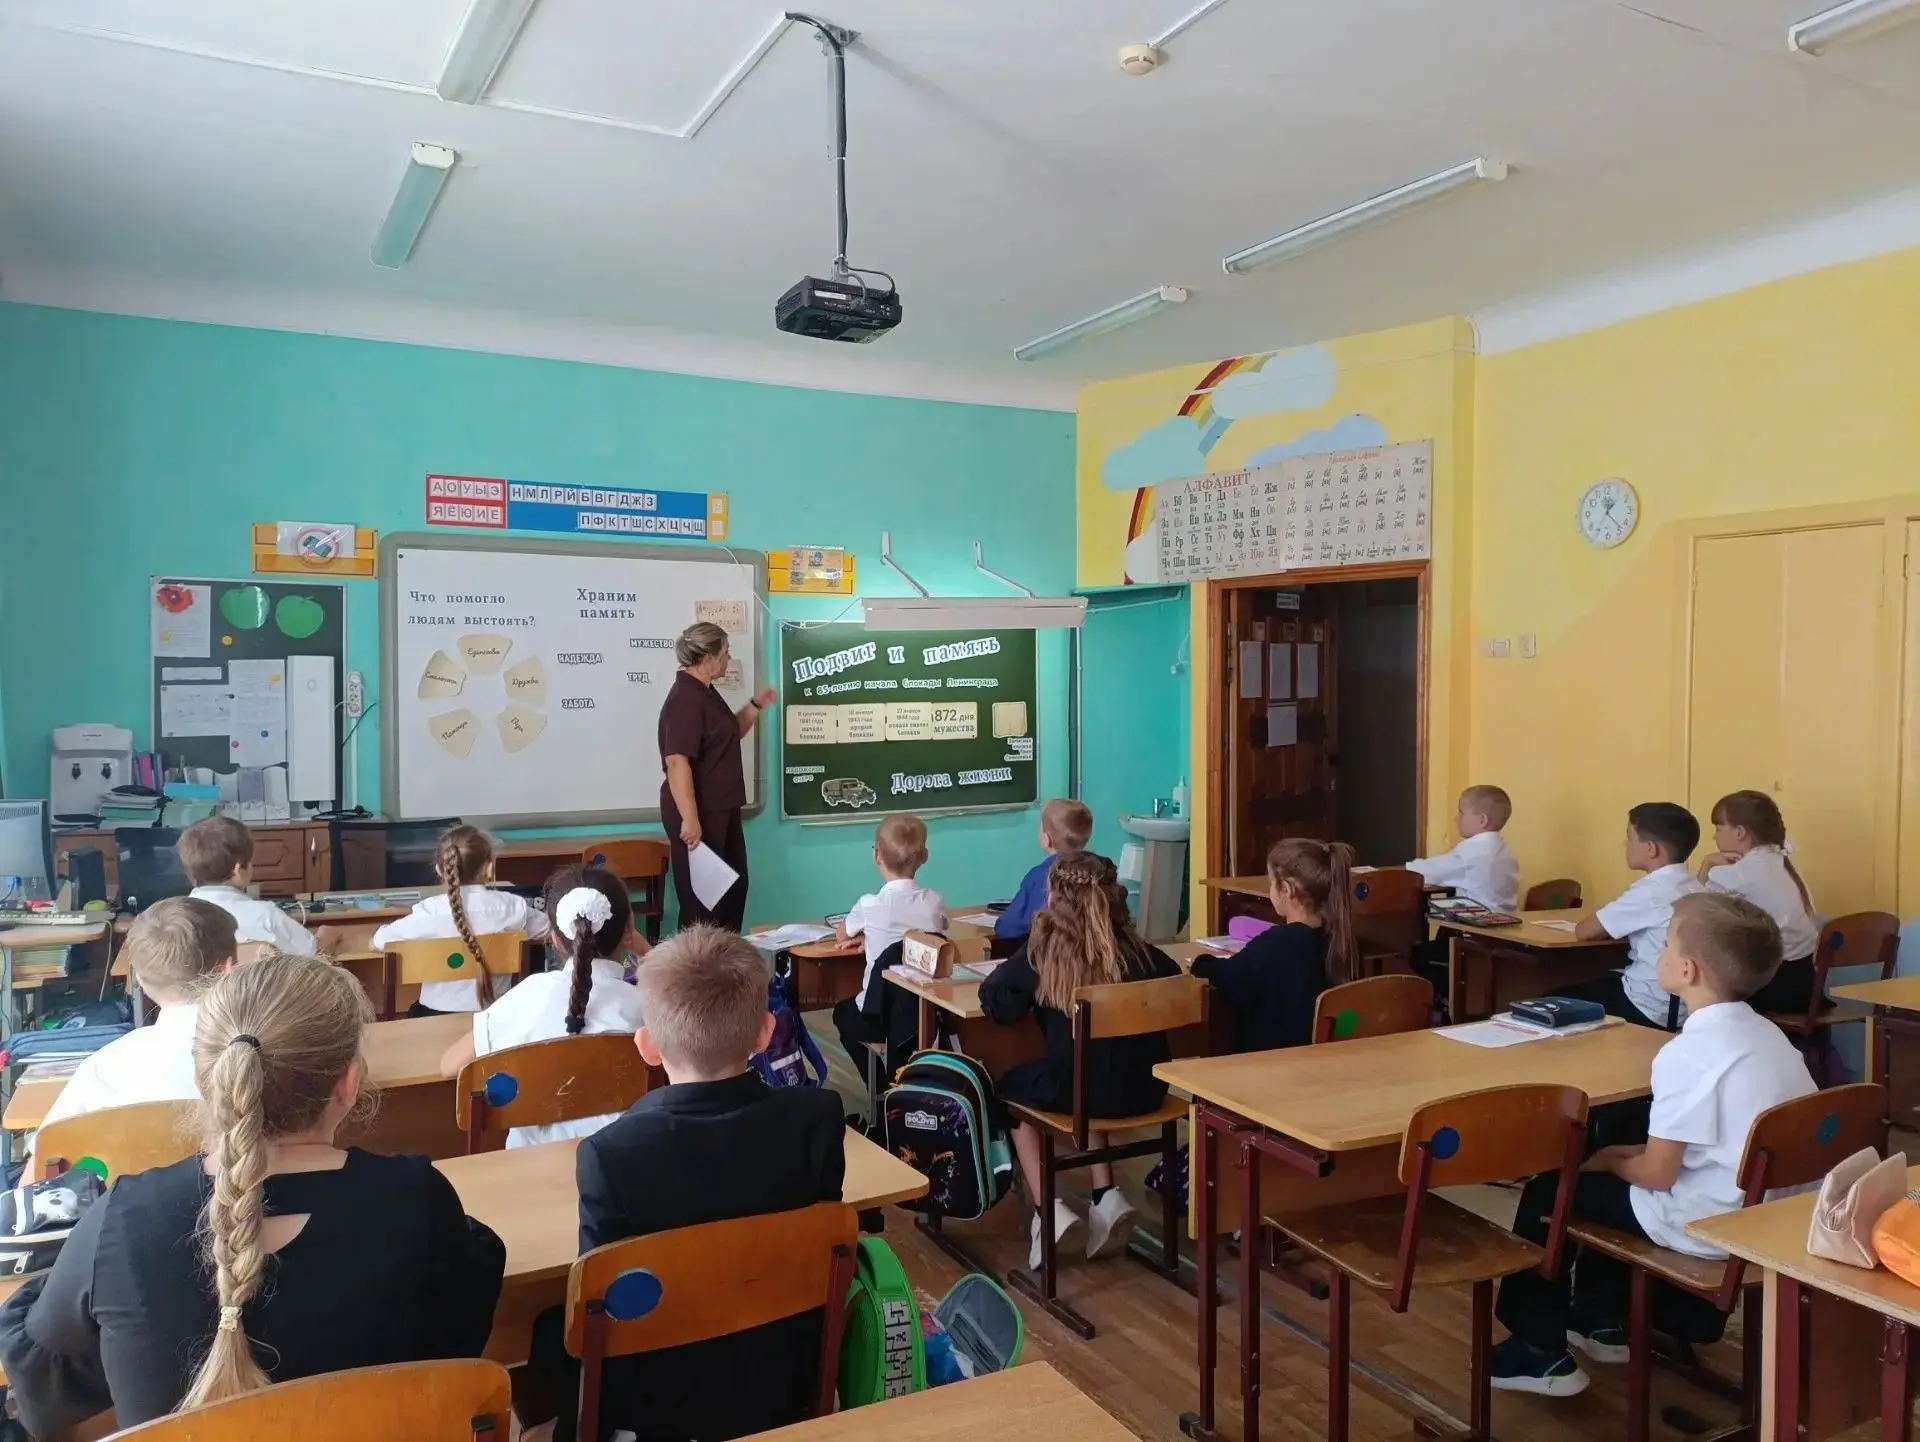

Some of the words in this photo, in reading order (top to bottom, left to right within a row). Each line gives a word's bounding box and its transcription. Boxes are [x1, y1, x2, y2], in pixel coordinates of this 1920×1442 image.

[1184, 473, 1250, 493] АЛФАВИТ
[410, 591, 436, 602] Что
[446, 594, 506, 604] помогло
[577, 588, 637, 603] Храним
[580, 608, 635, 618] память
[408, 616, 456, 626] людям
[464, 616, 535, 627] выстоять?
[630, 638, 674, 648] МУЖЕСТВО
[558, 653, 603, 664] НАДЕЖДА
[793, 642, 876, 682] Подвиг
[889, 647, 904, 662] и
[924, 638, 1000, 664] память
[627, 672, 650, 684] ТРУД
[816, 680, 861, 696] 85-летию
[864, 680, 898, 689] начала
[902, 678, 942, 688] блокады
[946, 678, 998, 688] Ленинграда
[562, 698, 595, 708] ЗАБОТА
[934, 708, 957, 722] 872
[960, 714, 974, 722] дня
[934, 725, 974, 734] мужества
[892, 773, 952, 794] Дорога
[958, 768, 1012, 784] жизни
